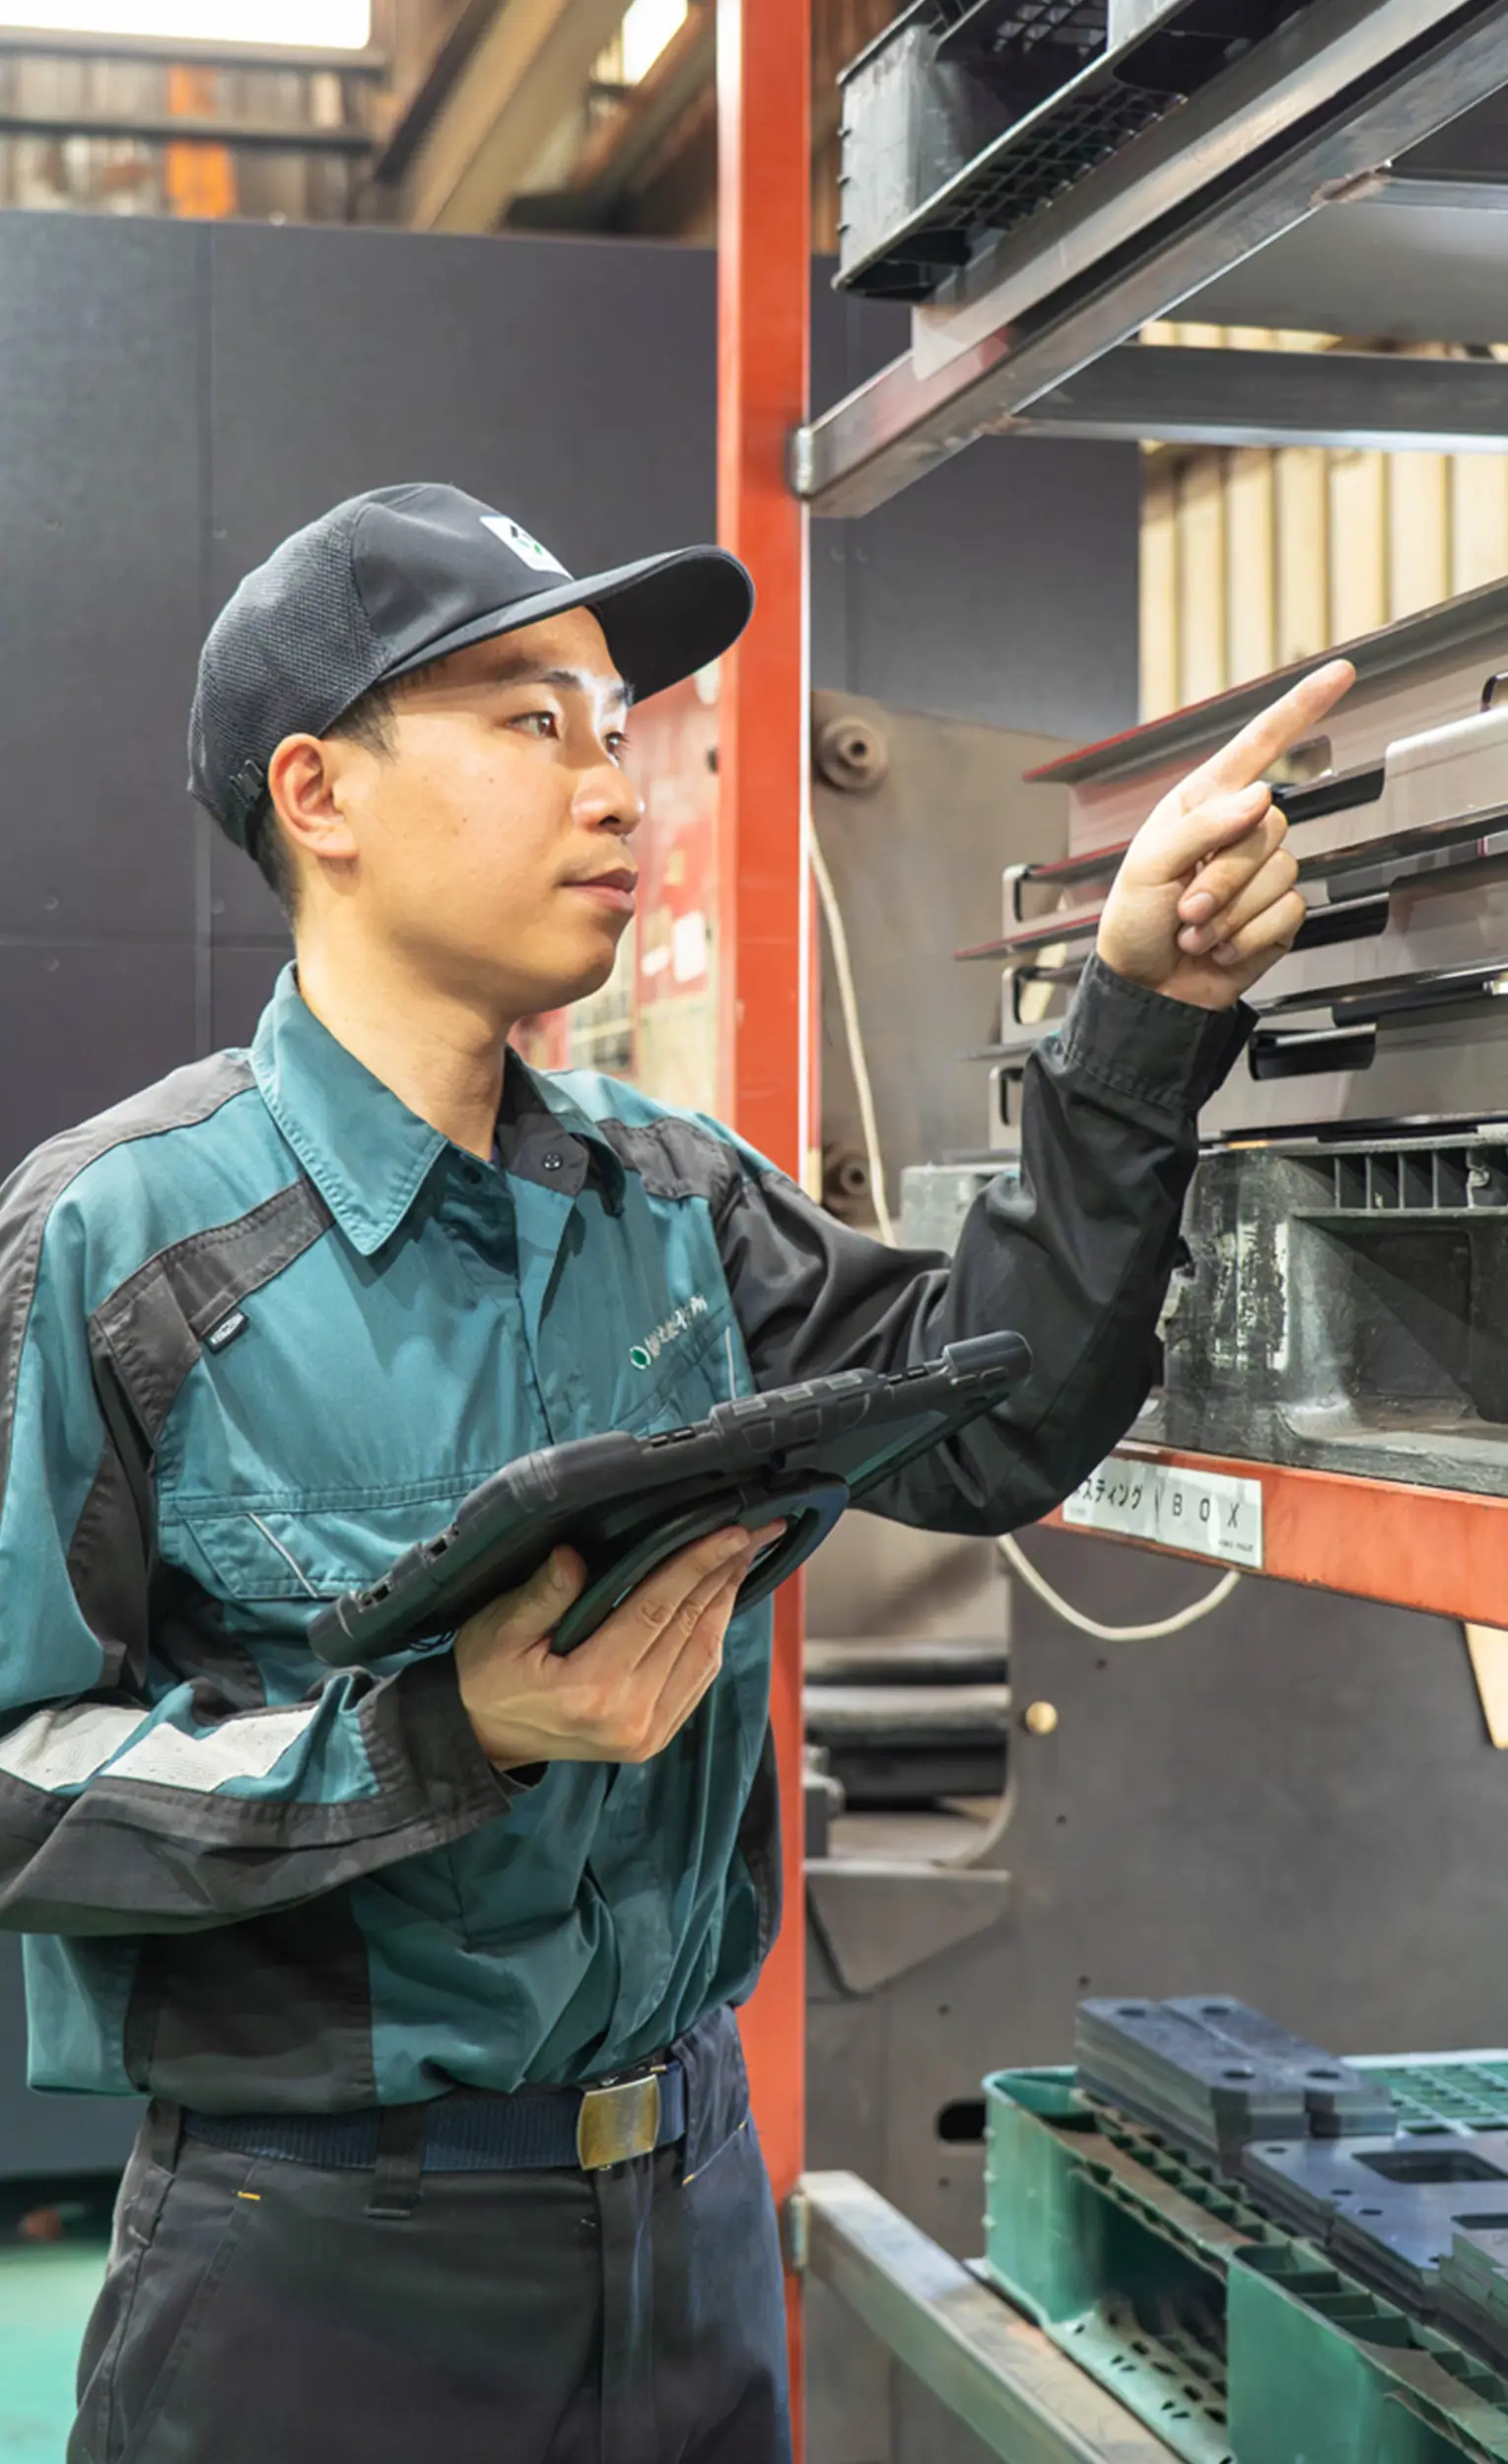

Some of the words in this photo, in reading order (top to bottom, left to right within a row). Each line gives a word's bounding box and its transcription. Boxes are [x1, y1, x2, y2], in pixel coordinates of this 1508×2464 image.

[1073, 1478, 1143, 1510] スティング
